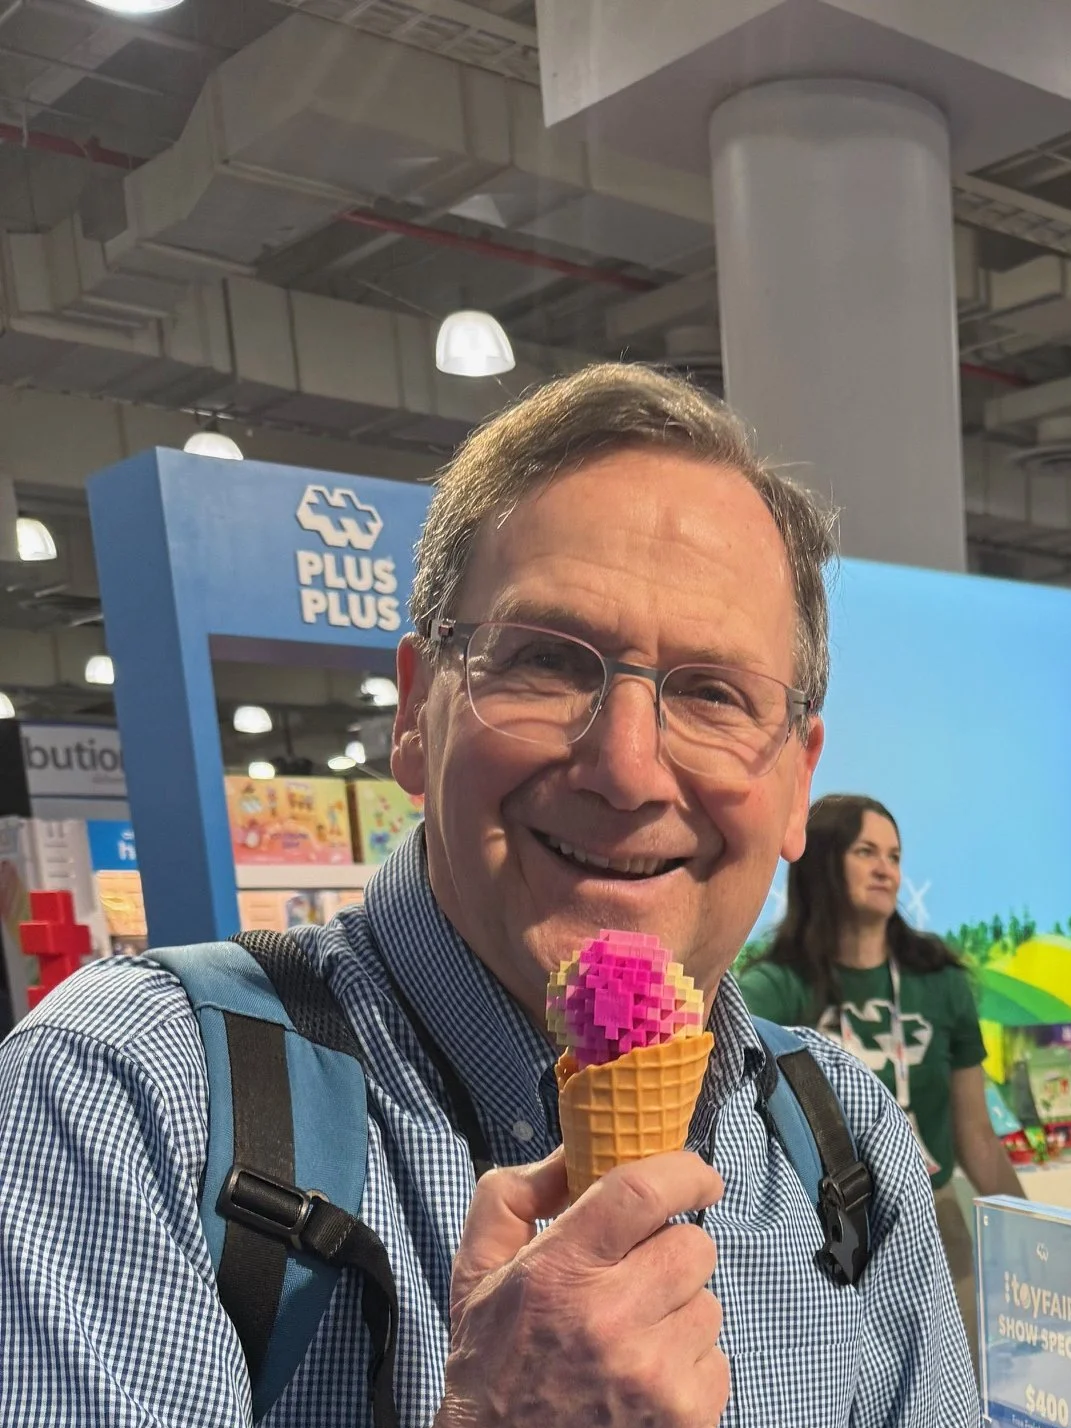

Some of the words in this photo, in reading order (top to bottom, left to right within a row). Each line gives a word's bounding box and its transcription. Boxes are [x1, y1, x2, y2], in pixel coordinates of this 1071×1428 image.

[297, 549, 398, 595] PLUS
[300, 587, 401, 632] PLUS
[998, 1313, 1038, 1347] SHOW
[1024, 1383, 1069, 1428] $400
